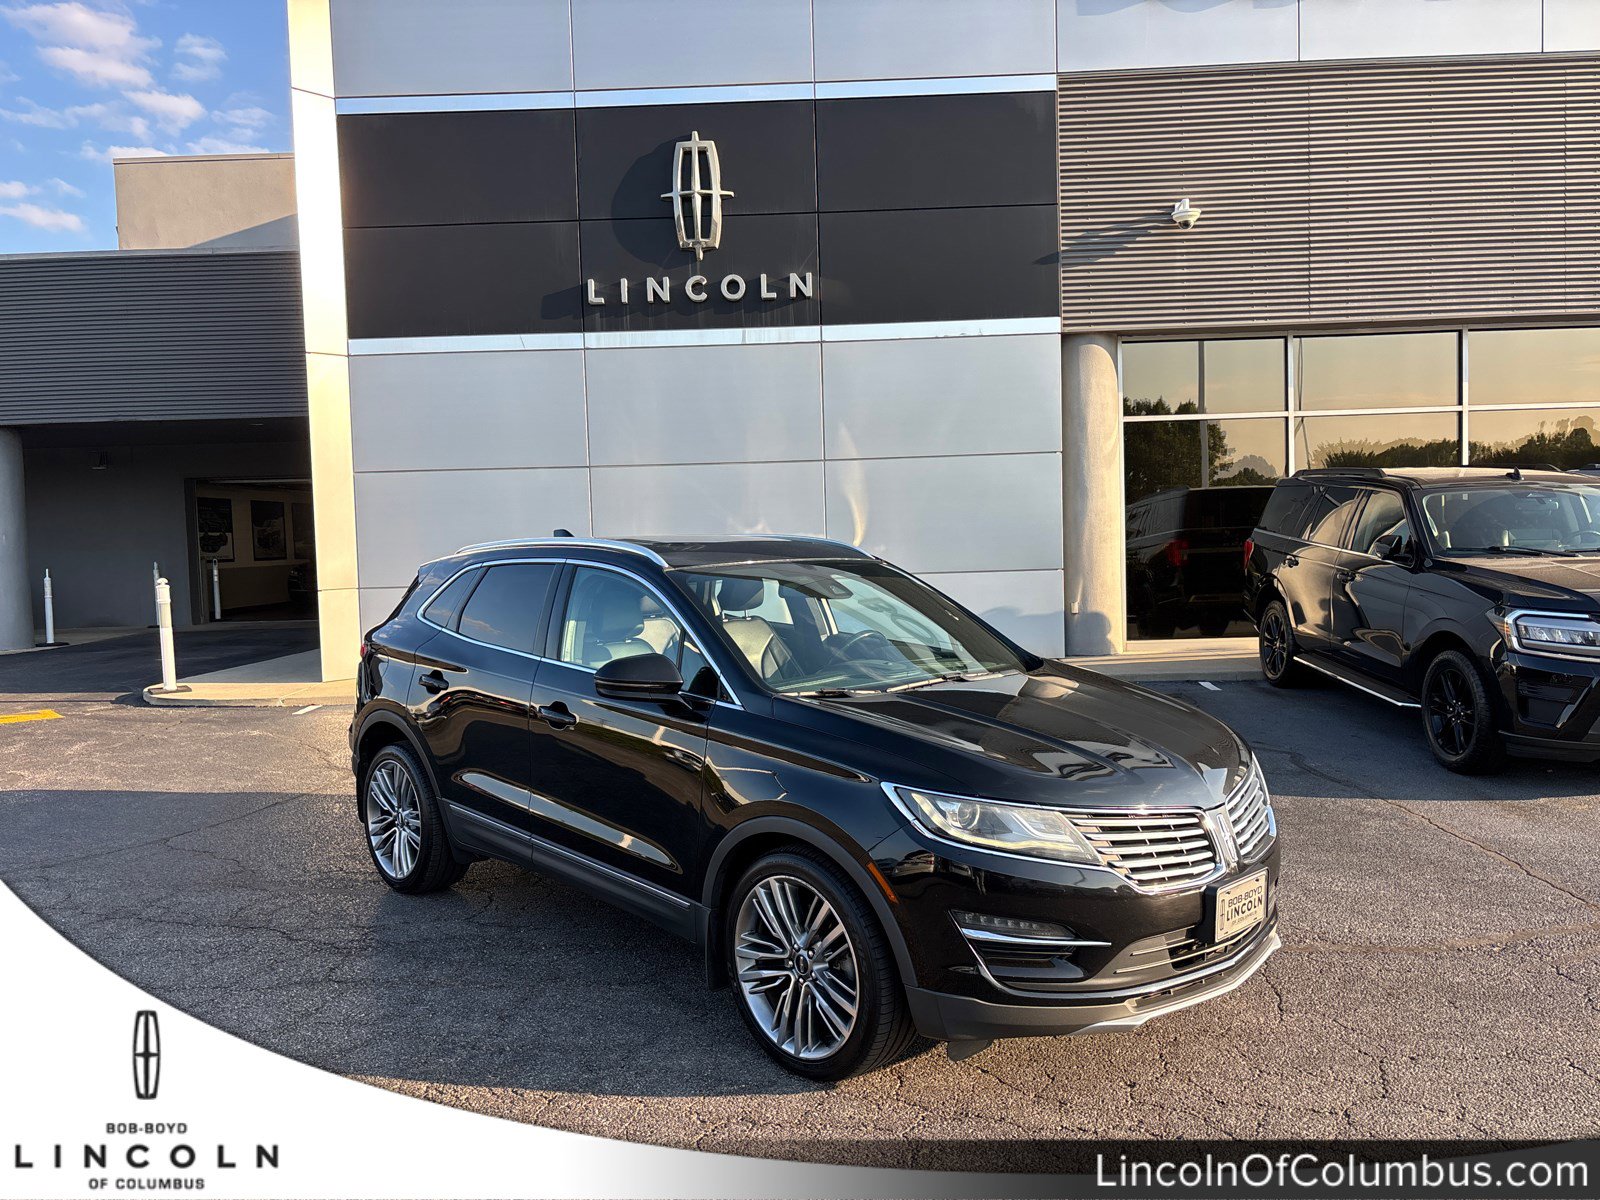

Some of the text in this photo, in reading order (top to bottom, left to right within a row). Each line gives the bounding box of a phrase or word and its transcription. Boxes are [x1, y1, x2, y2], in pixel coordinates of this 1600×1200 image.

[587, 272, 813, 304] LINCOLN
[1226, 895, 1263, 921] LINCOLN
[1228, 886, 1263, 908] BOB-BOYD
